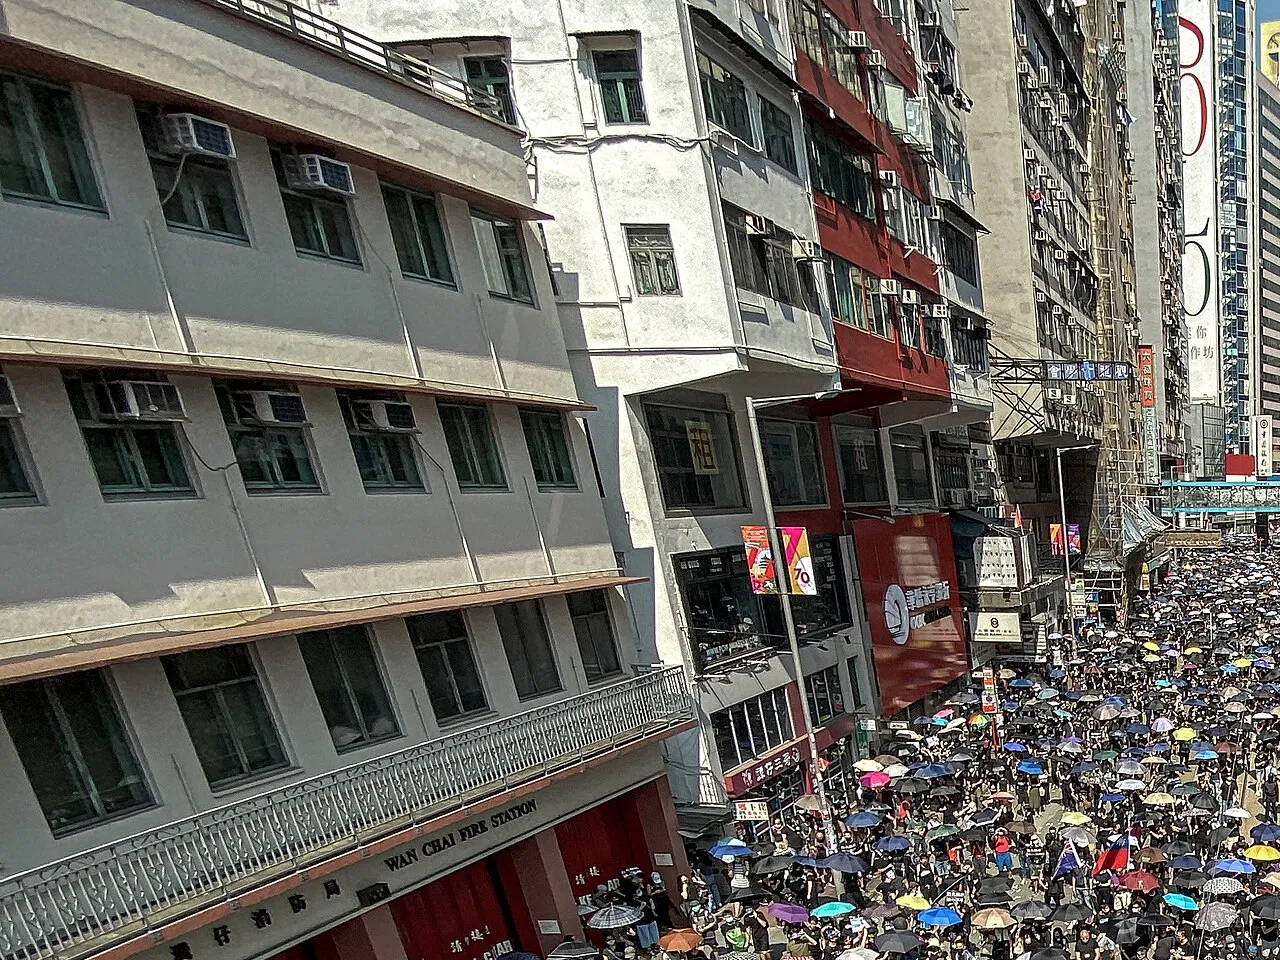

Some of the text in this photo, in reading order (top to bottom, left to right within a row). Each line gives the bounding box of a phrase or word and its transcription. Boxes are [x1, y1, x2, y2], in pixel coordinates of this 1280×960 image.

[793, 568, 810, 584] 70
[384, 799, 537, 873] WAN CHAI FIRE STATION
